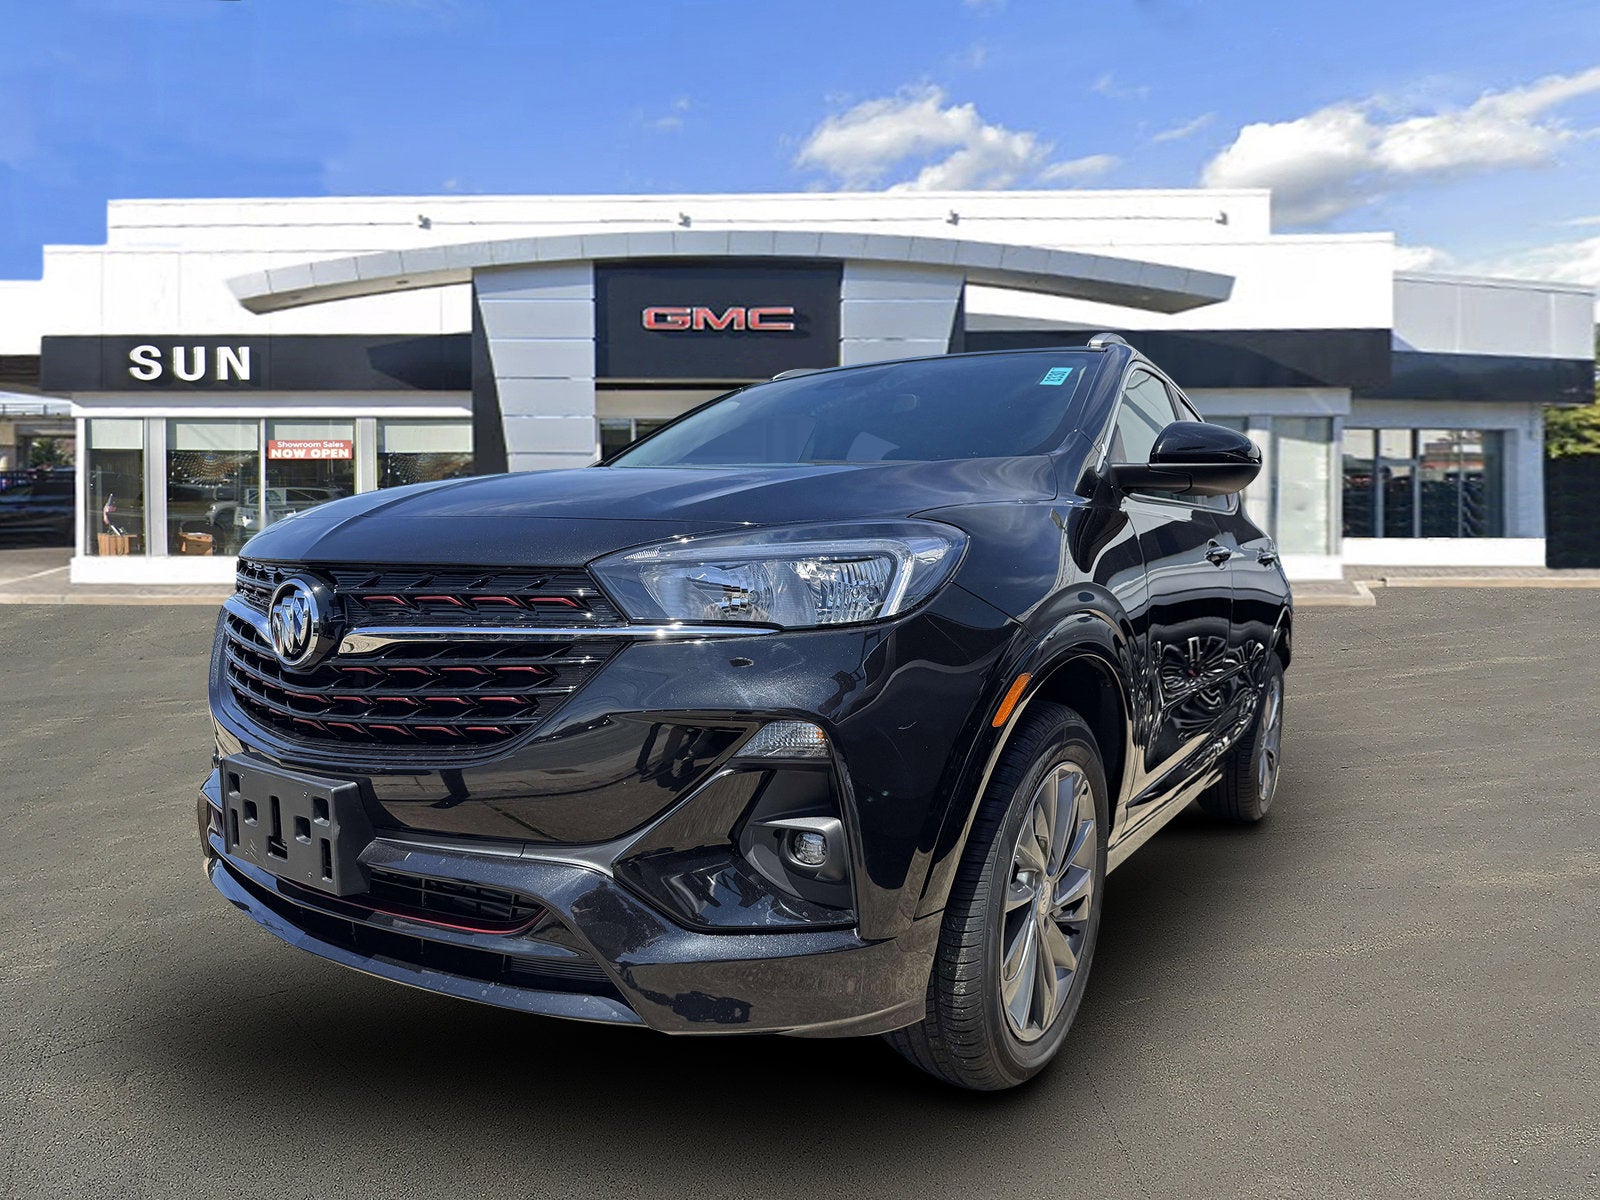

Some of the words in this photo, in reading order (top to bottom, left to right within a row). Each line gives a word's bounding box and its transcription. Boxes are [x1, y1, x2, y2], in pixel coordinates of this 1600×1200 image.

[642, 307, 795, 330] GMC
[129, 345, 250, 381] SUN
[271, 448, 306, 459] NOW
[310, 448, 349, 459] OPEN
